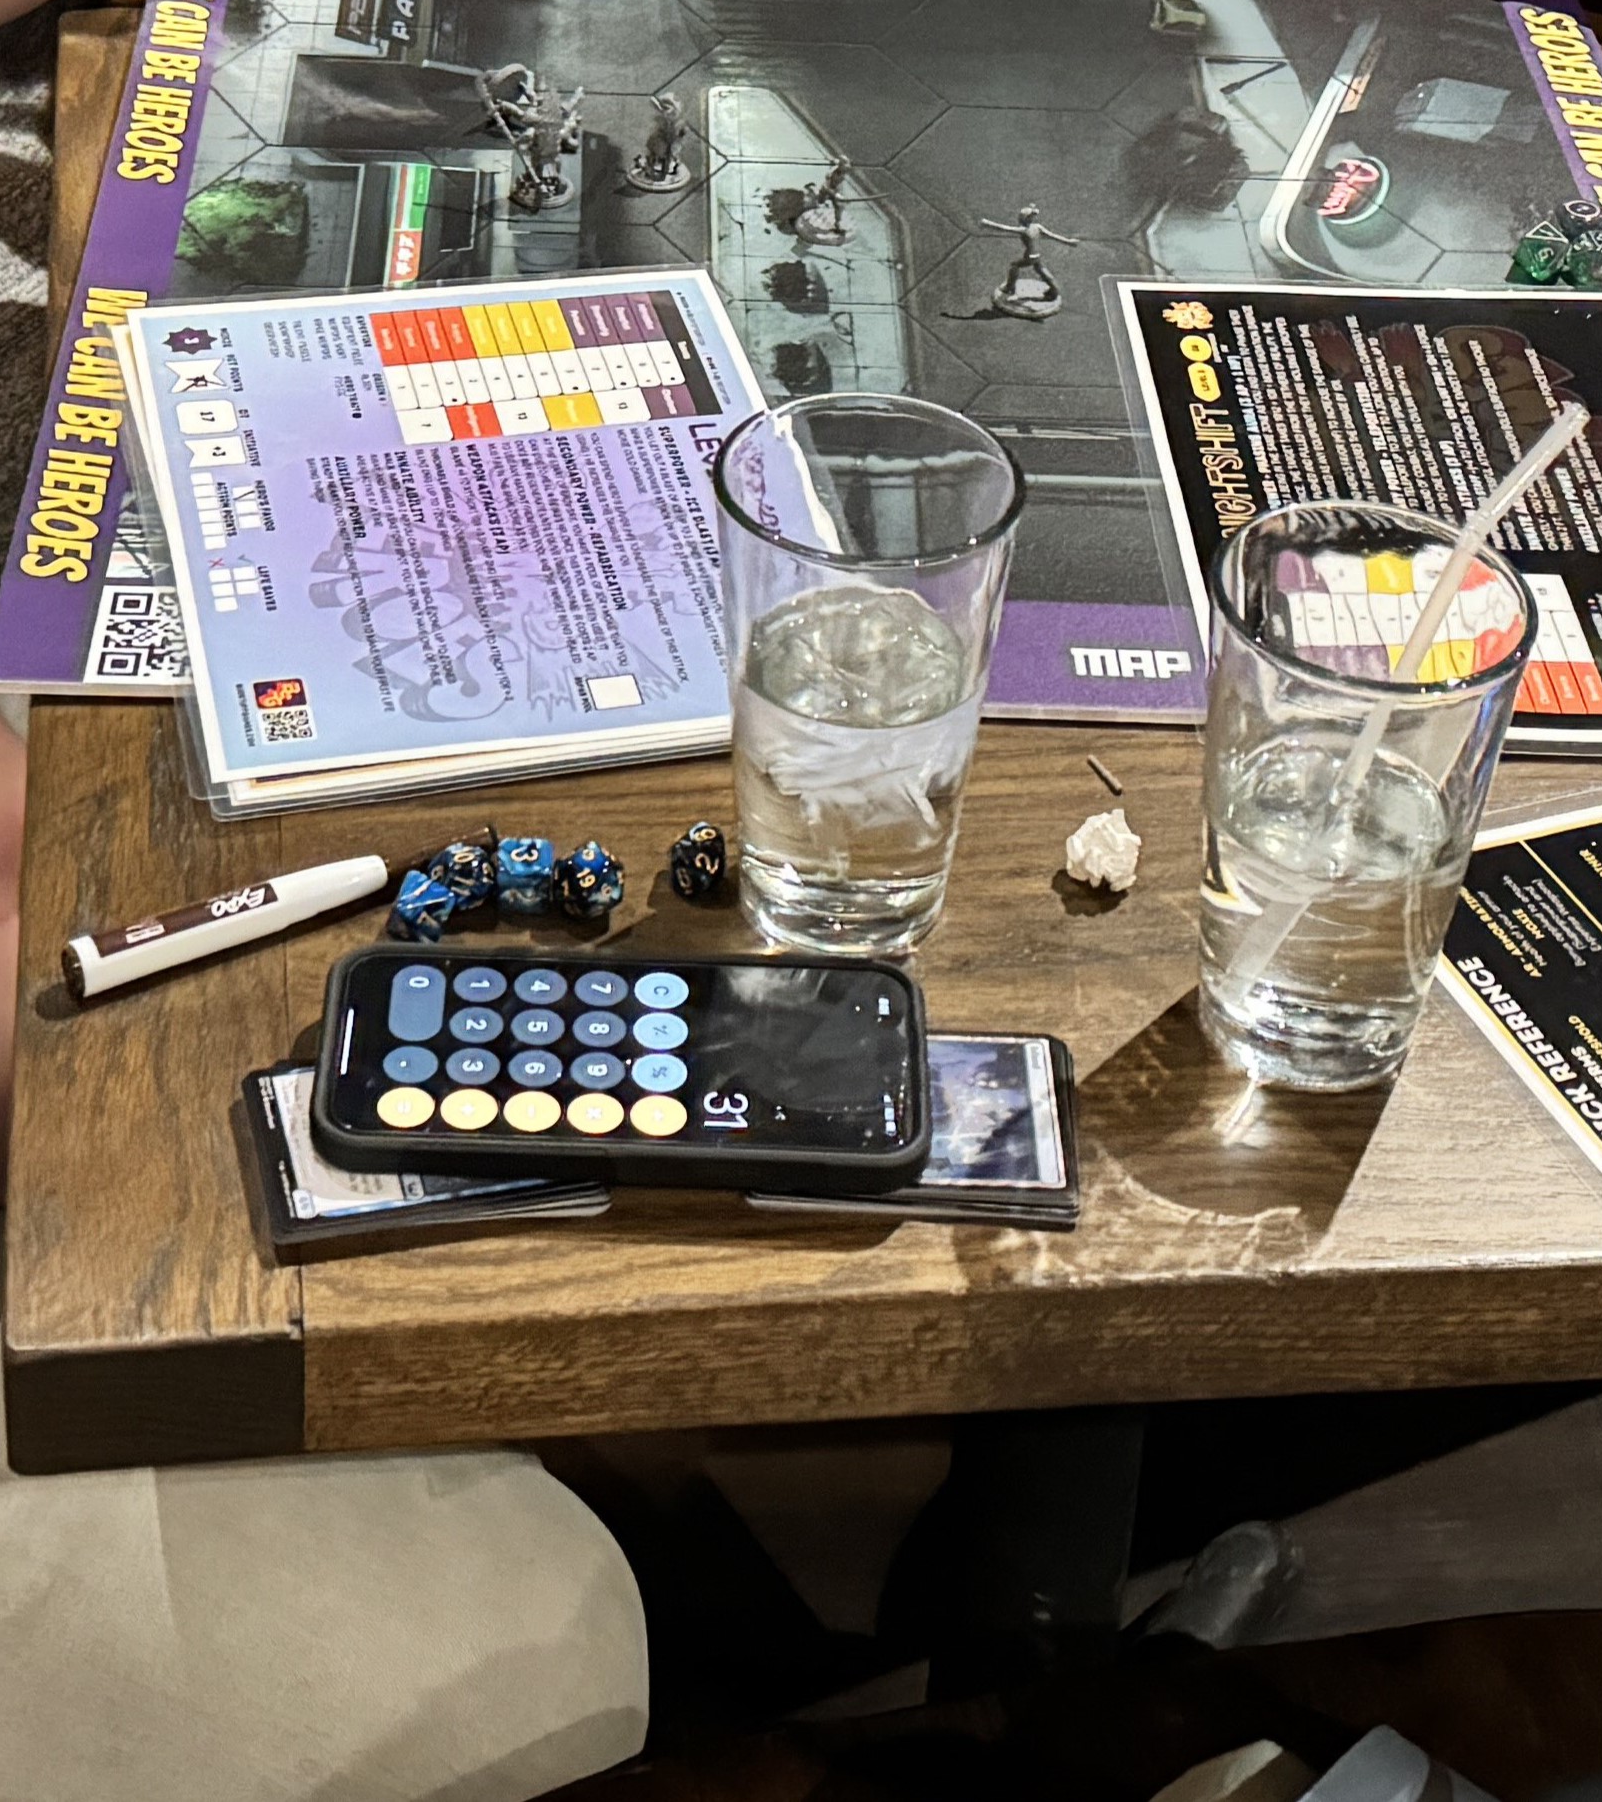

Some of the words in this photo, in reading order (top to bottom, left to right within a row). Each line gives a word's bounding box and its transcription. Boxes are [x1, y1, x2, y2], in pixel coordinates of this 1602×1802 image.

[149, 0, 211, 51] CAN
[142, 49, 202, 86] BE
[116, 83, 194, 187] HEROES
[81, 286, 149, 329] WE
[64, 336, 127, 401] CAN
[54, 402, 124, 448] BE
[199, 411, 215, 422] 17
[228, 367, 243, 392] POINTS
[242, 429, 260, 466] INITIATIVE
[1350, 381, 1391, 450] TELEPORTATION
[210, 446, 226, 456] +3
[657, 426, 692, 488] SUPERPOWER
[464, 444, 487, 481] WEAPON
[476, 483, 501, 525] ATTACKS
[1180, 403, 1269, 539] NIGHTSHIFT
[1378, 458, 1403, 490] POWER
[1552, 467, 1580, 499] POWER
[1573, 469, 1589, 482] YOU
[215, 481, 230, 508] ACTION
[253, 479, 269, 505] HERO'S
[333, 455, 356, 502] AUXILIARY
[346, 505, 366, 538] POWER
[393, 451, 414, 484] INNATE
[404, 485, 426, 524] ABILITY
[1447, 467, 1477, 508] ATTACKS
[1580, 487, 1602, 514] ATTACK
[19, 447, 114, 584] HEROES
[260, 507, 275, 531] FAVOR
[684, 497, 702, 512] ICE
[221, 509, 237, 537] POINTS
[554, 436, 584, 490] SECONDARY
[573, 491, 596, 524] POWER
[588, 532, 627, 611] REFABRICATION
[691, 515, 714, 544] BLAST
[1517, 515, 1545, 550] INNATE
[1537, 518, 1561, 550] GHOSTLY
[1566, 501, 1601, 552] AUXILIARY
[256, 565, 270, 583] LIFE
[649, 598, 668, 625] DAMAGE
[664, 638, 679, 654] THIS
[1070, 647, 1192, 679] MAP
[382, 696, 395, 712] LIFE
[509, 846, 539, 863] 3
[576, 869, 597, 889] 19
[207, 883, 268, 917] EXPO
[1510, 907, 1547, 939] MOXIE
[1486, 922, 1524, 957] ARMOR
[409, 977, 429, 987] 0
[469, 980, 489, 988] 1
[529, 980, 551, 991] 4
[1520, 962, 1543, 978] AR
[590, 983, 611, 992] 7
[652, 986, 669, 995] C
[465, 1019, 486, 1030] 2
[527, 1021, 548, 1031] 5
[589, 1023, 610, 1033] 8
[1454, 955, 1579, 1083] REFERENCE
[461, 1060, 483, 1071] 3
[524, 1063, 545, 1073] 6
[585, 1064, 607, 1075] 9
[700, 1091, 751, 1131] 31
